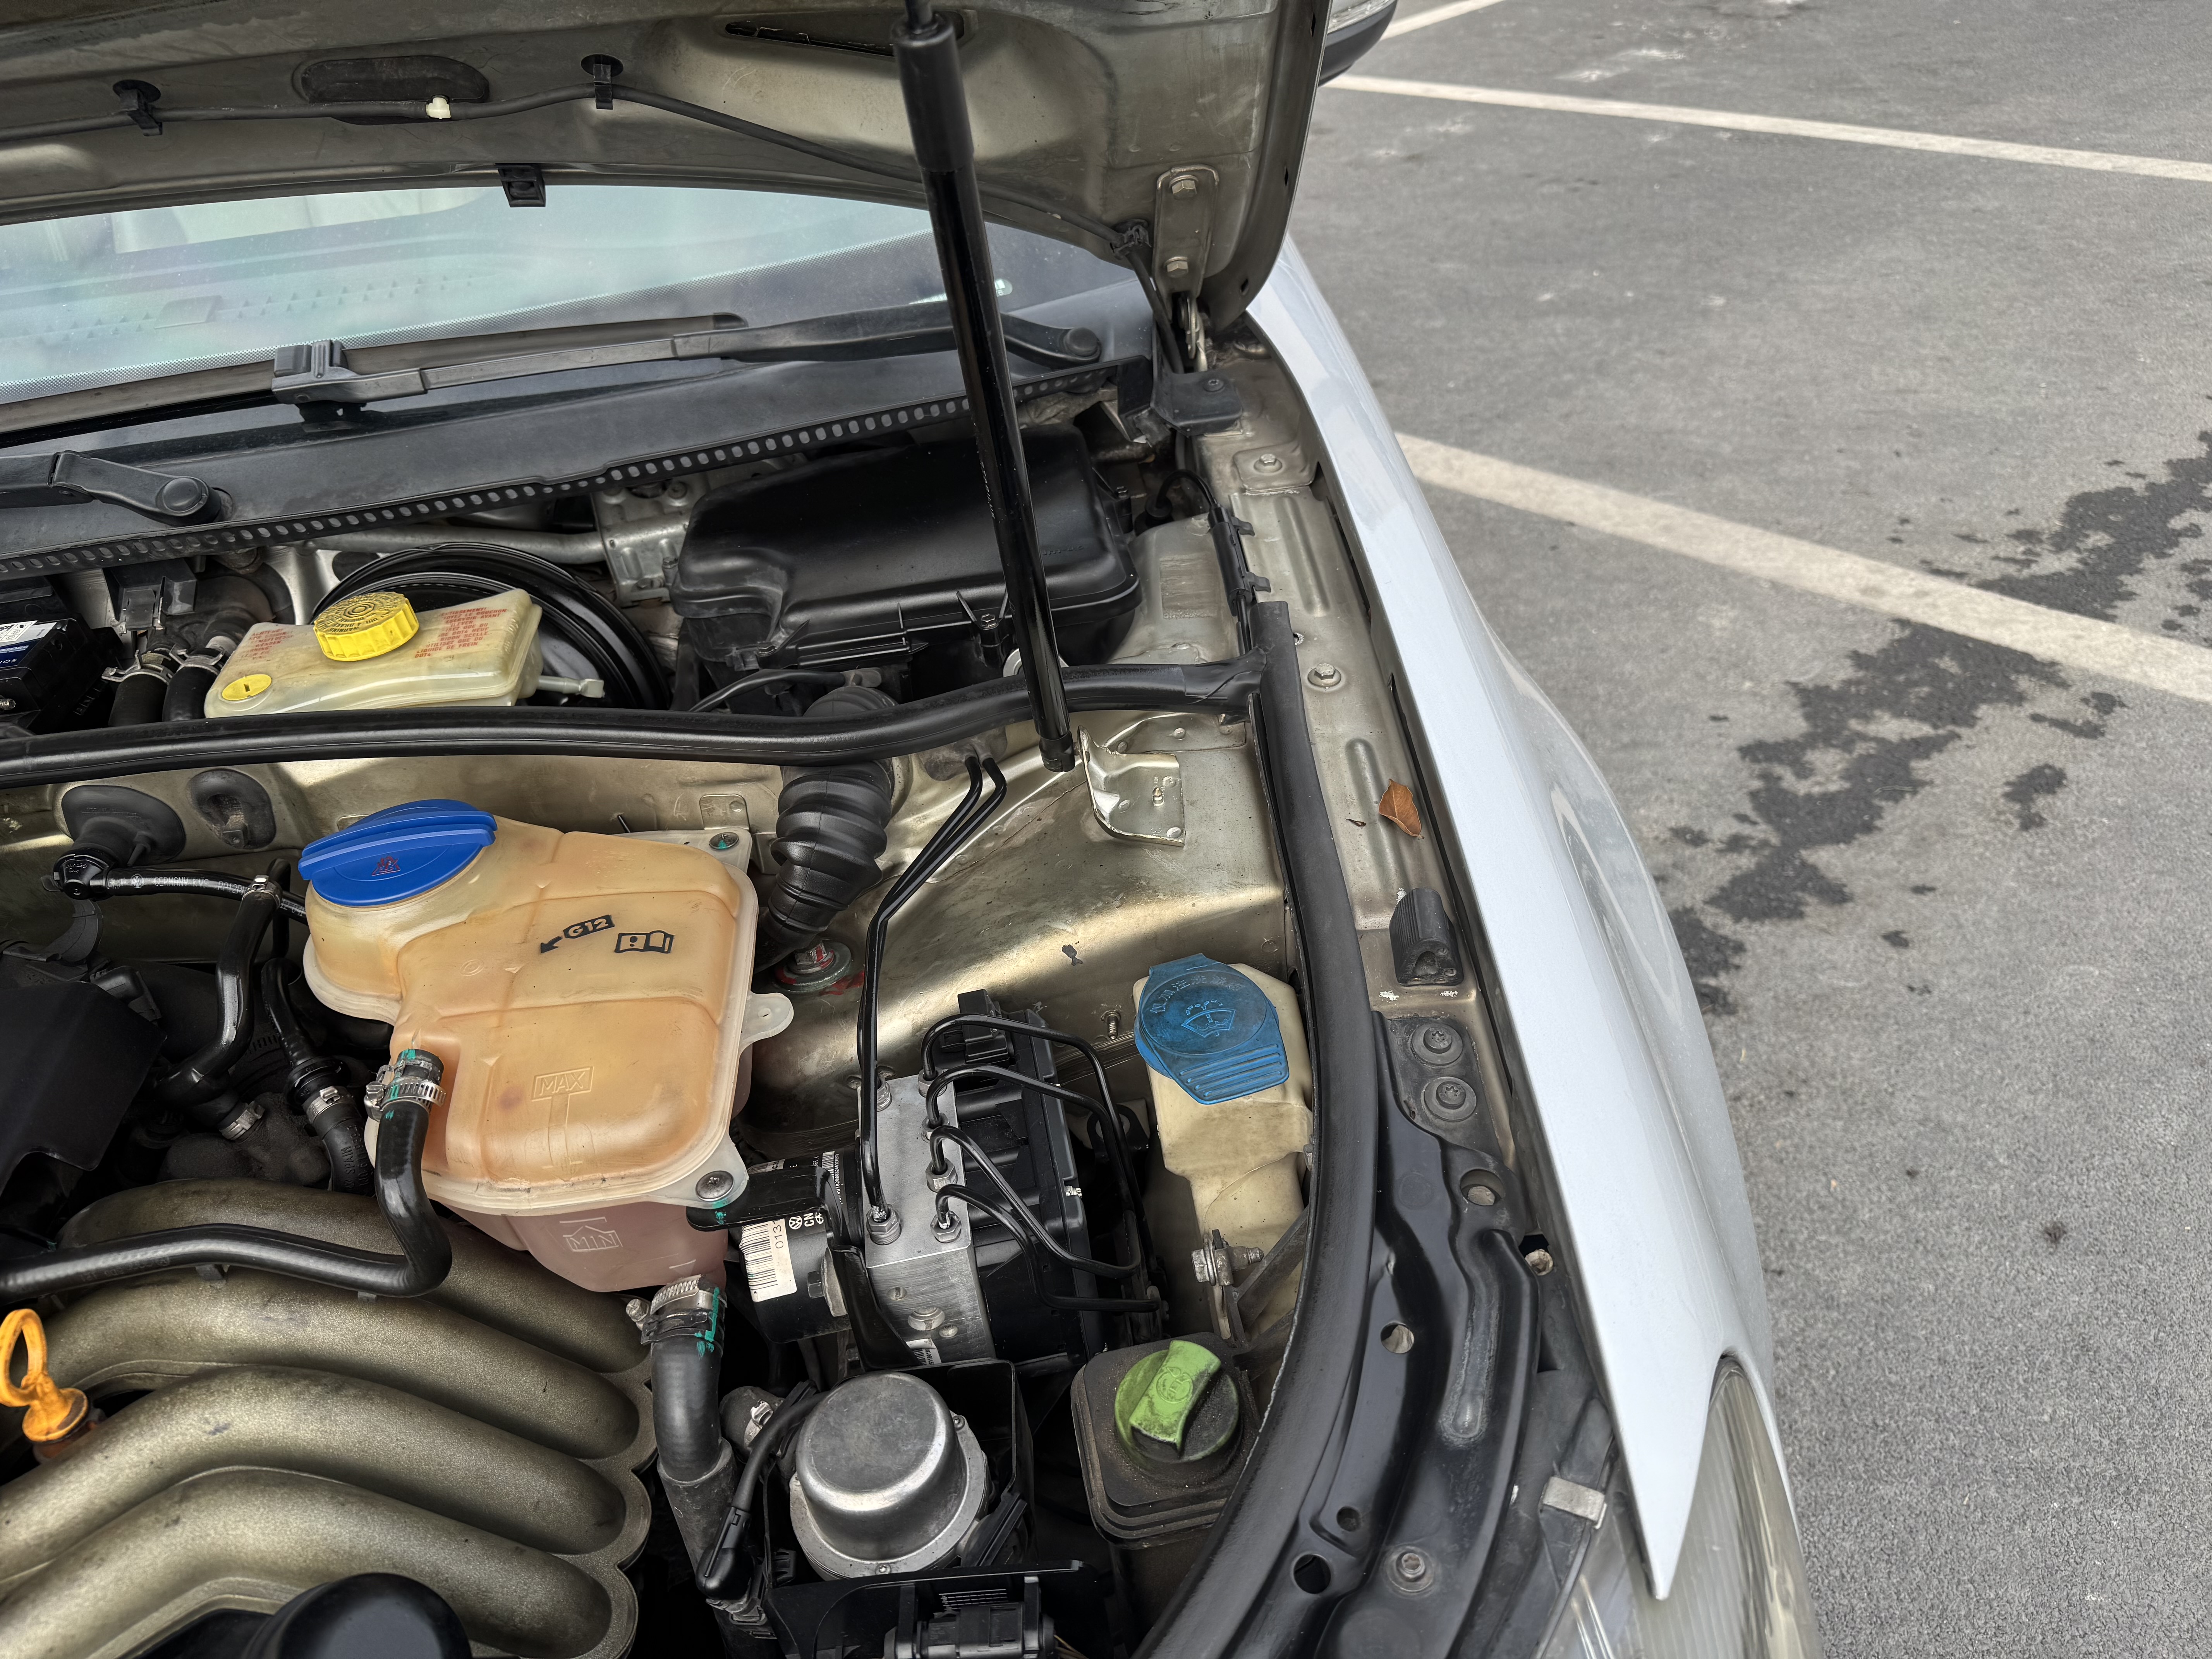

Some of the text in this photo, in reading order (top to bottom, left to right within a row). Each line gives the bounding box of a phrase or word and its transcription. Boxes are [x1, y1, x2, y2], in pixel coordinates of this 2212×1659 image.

[154, 876, 189, 887] GERMANY
[568, 917, 609, 936] G12
[539, 1072, 585, 1096] MAX
[341, 1146, 356, 1174] SPAIN
[804, 1212, 815, 1227] CN
[570, 1233, 617, 1250] MIN
